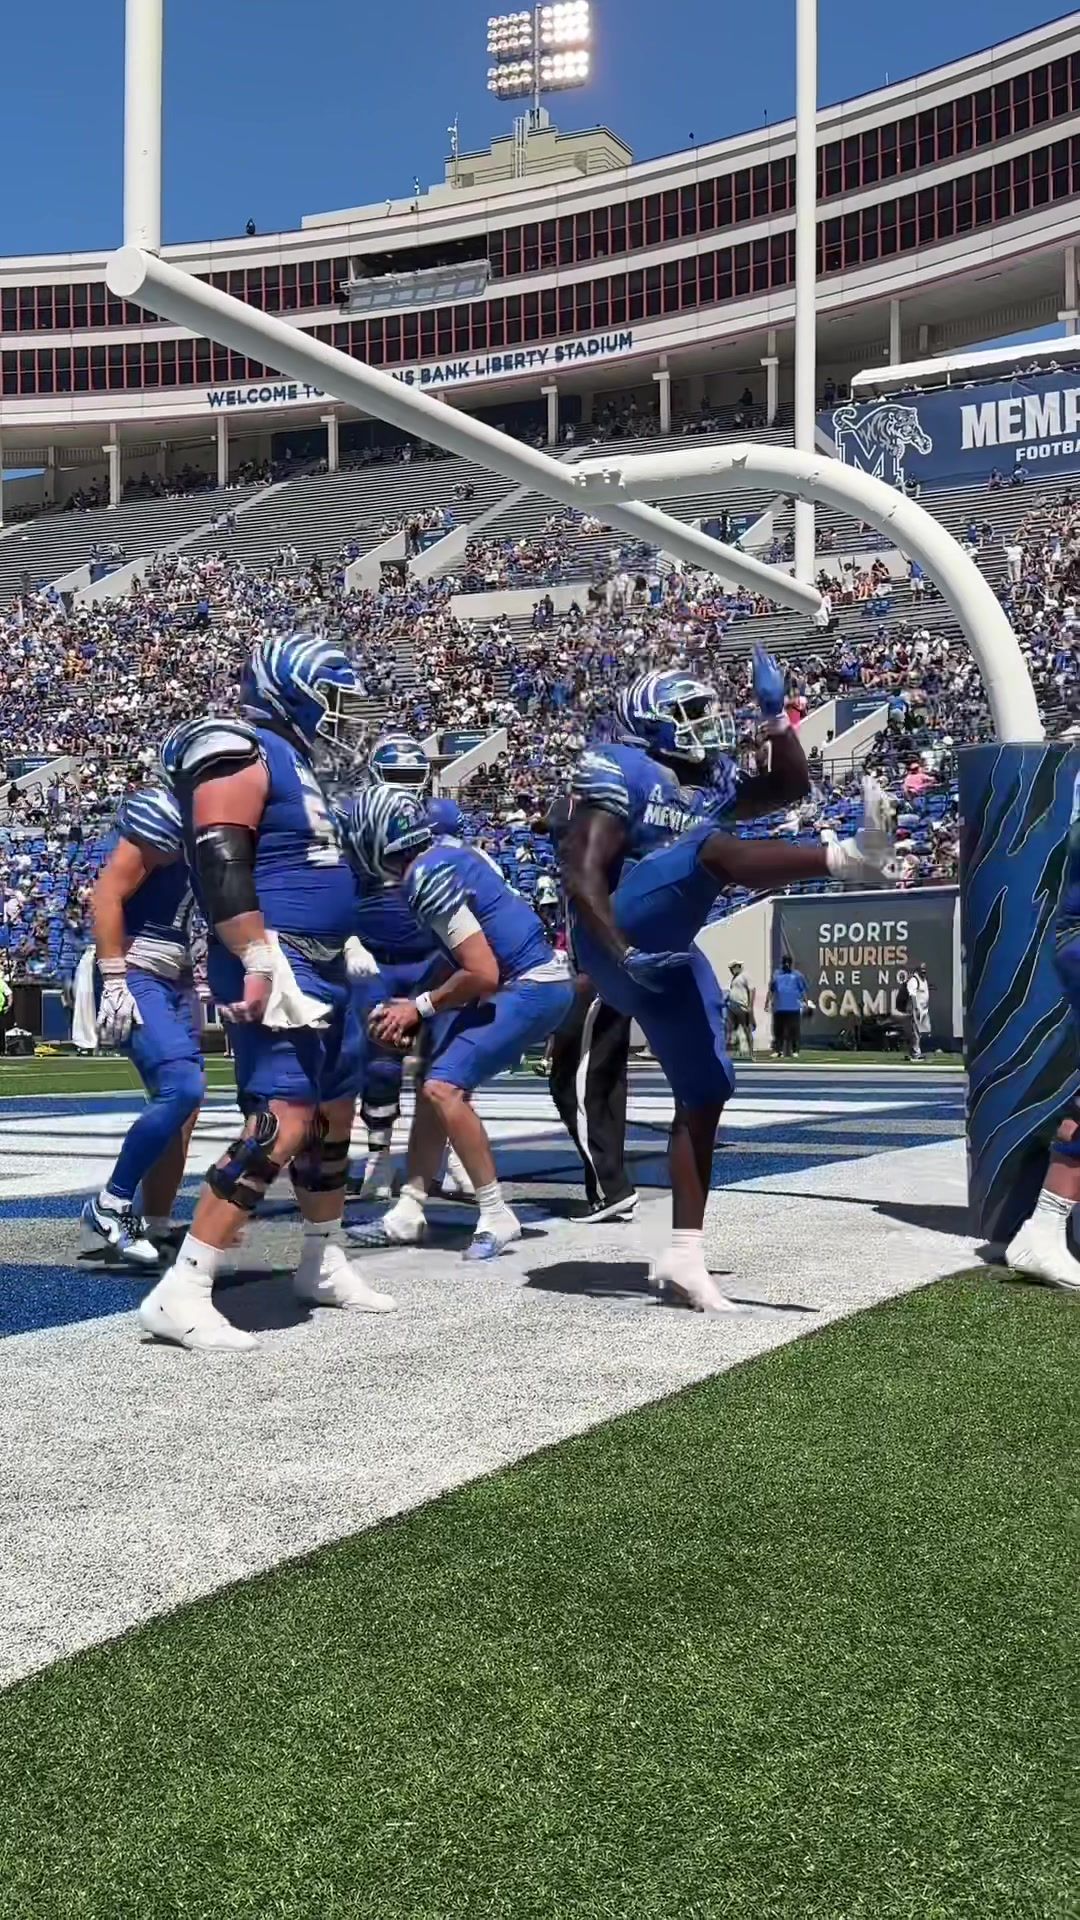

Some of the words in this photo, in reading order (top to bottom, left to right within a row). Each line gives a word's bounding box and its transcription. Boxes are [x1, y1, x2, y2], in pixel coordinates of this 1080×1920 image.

[207, 384, 298, 408] WELCOME
[420, 361, 470, 385] BANK
[475, 347, 549, 376] LIBERTY
[554, 331, 633, 363] STADIUM
[818, 920, 909, 943] SPORTS
[819, 945, 908, 967] INJURIES
[818, 969, 861, 985] ARE
[877, 969, 908, 985] NO
